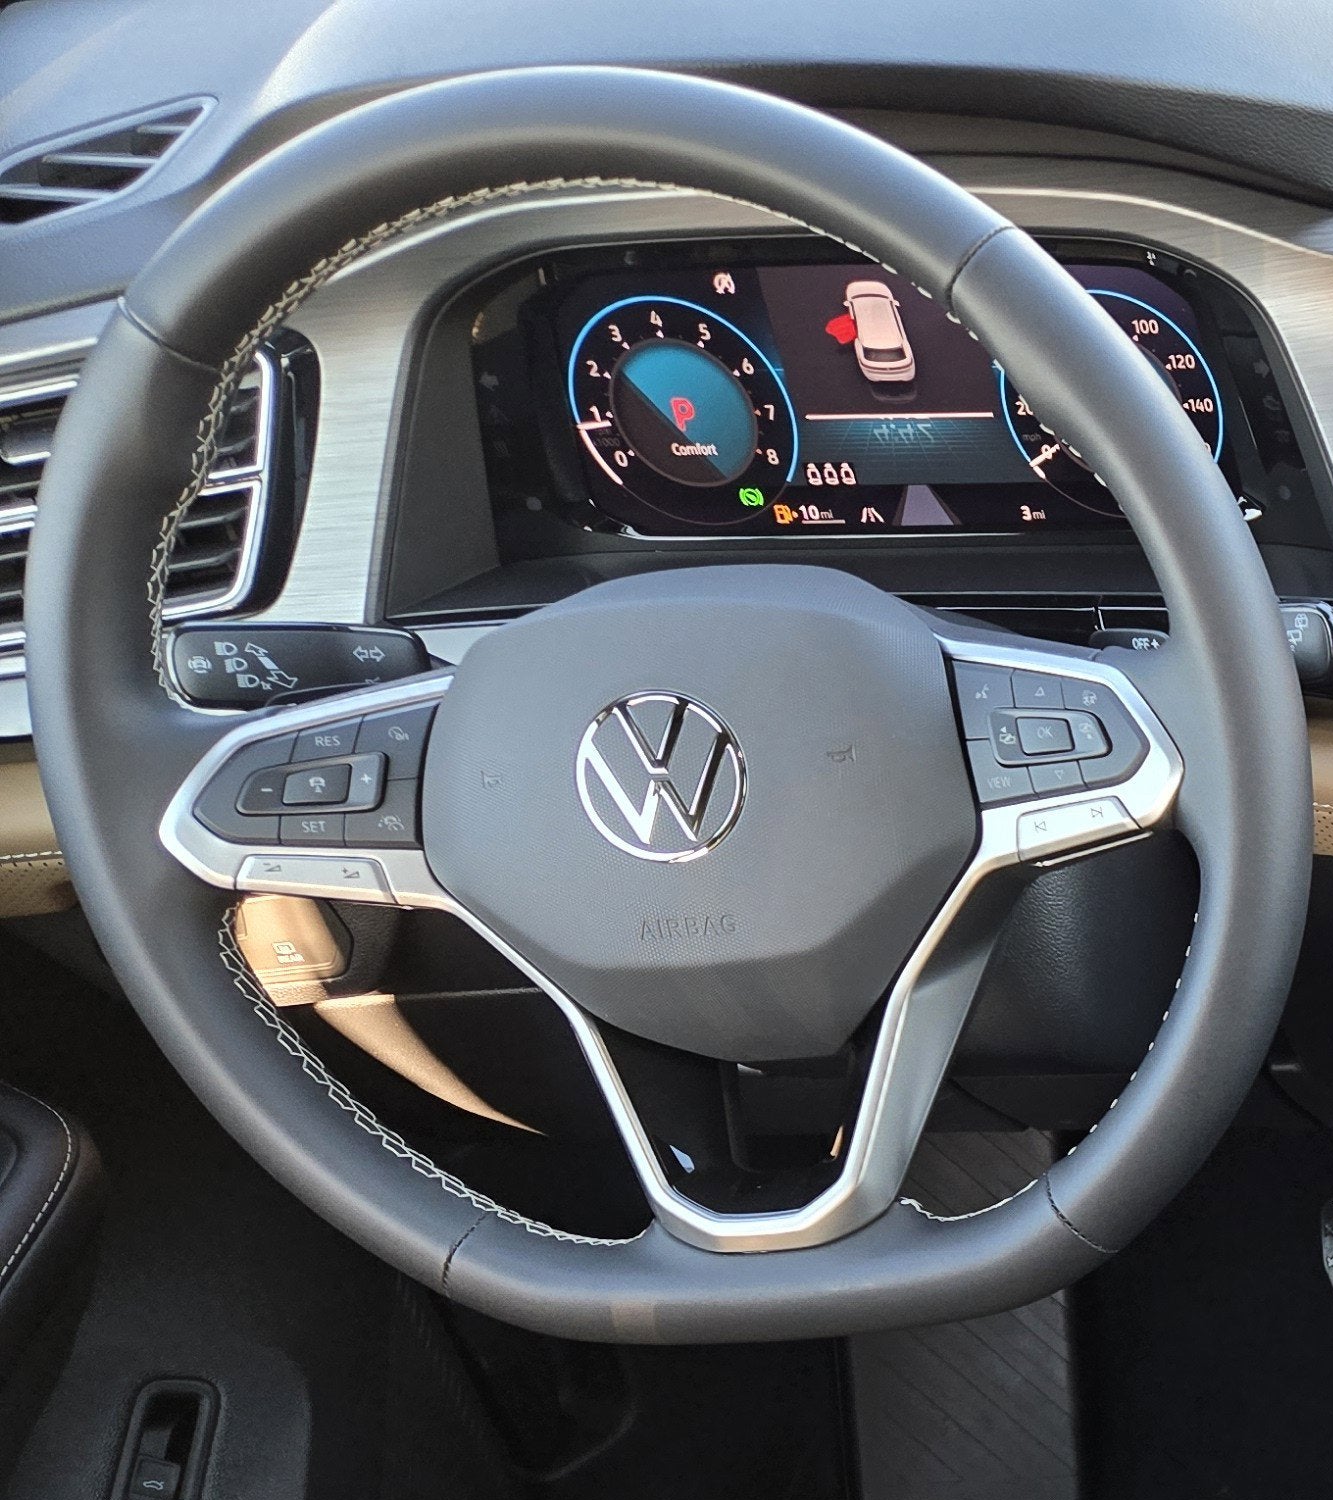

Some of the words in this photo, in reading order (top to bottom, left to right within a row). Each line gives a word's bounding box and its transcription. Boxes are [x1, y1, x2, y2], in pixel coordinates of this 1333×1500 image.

[649, 310, 663, 328] 4
[1131, 319, 1159, 336] 100
[608, 324, 622, 342] 3
[698, 323, 711, 341] 5
[586, 360, 600, 378] 2
[741, 358, 755, 375] 6
[1169, 354, 1195, 370] 120
[763, 404, 775, 421] 7
[1187, 397, 1214, 413] 140
[589, 405, 601, 423] 1
[670, 396, 695, 432] P
[671, 442, 719, 458] Comfort
[766, 448, 780, 466] 8
[614, 450, 628, 468] 0
[314, 734, 341, 747] RES
[1036, 725, 1054, 740] OK
[986, 776, 1013, 788] VIEW
[300, 820, 327, 833] SET
[640, 913, 737, 941] AIRBAG
